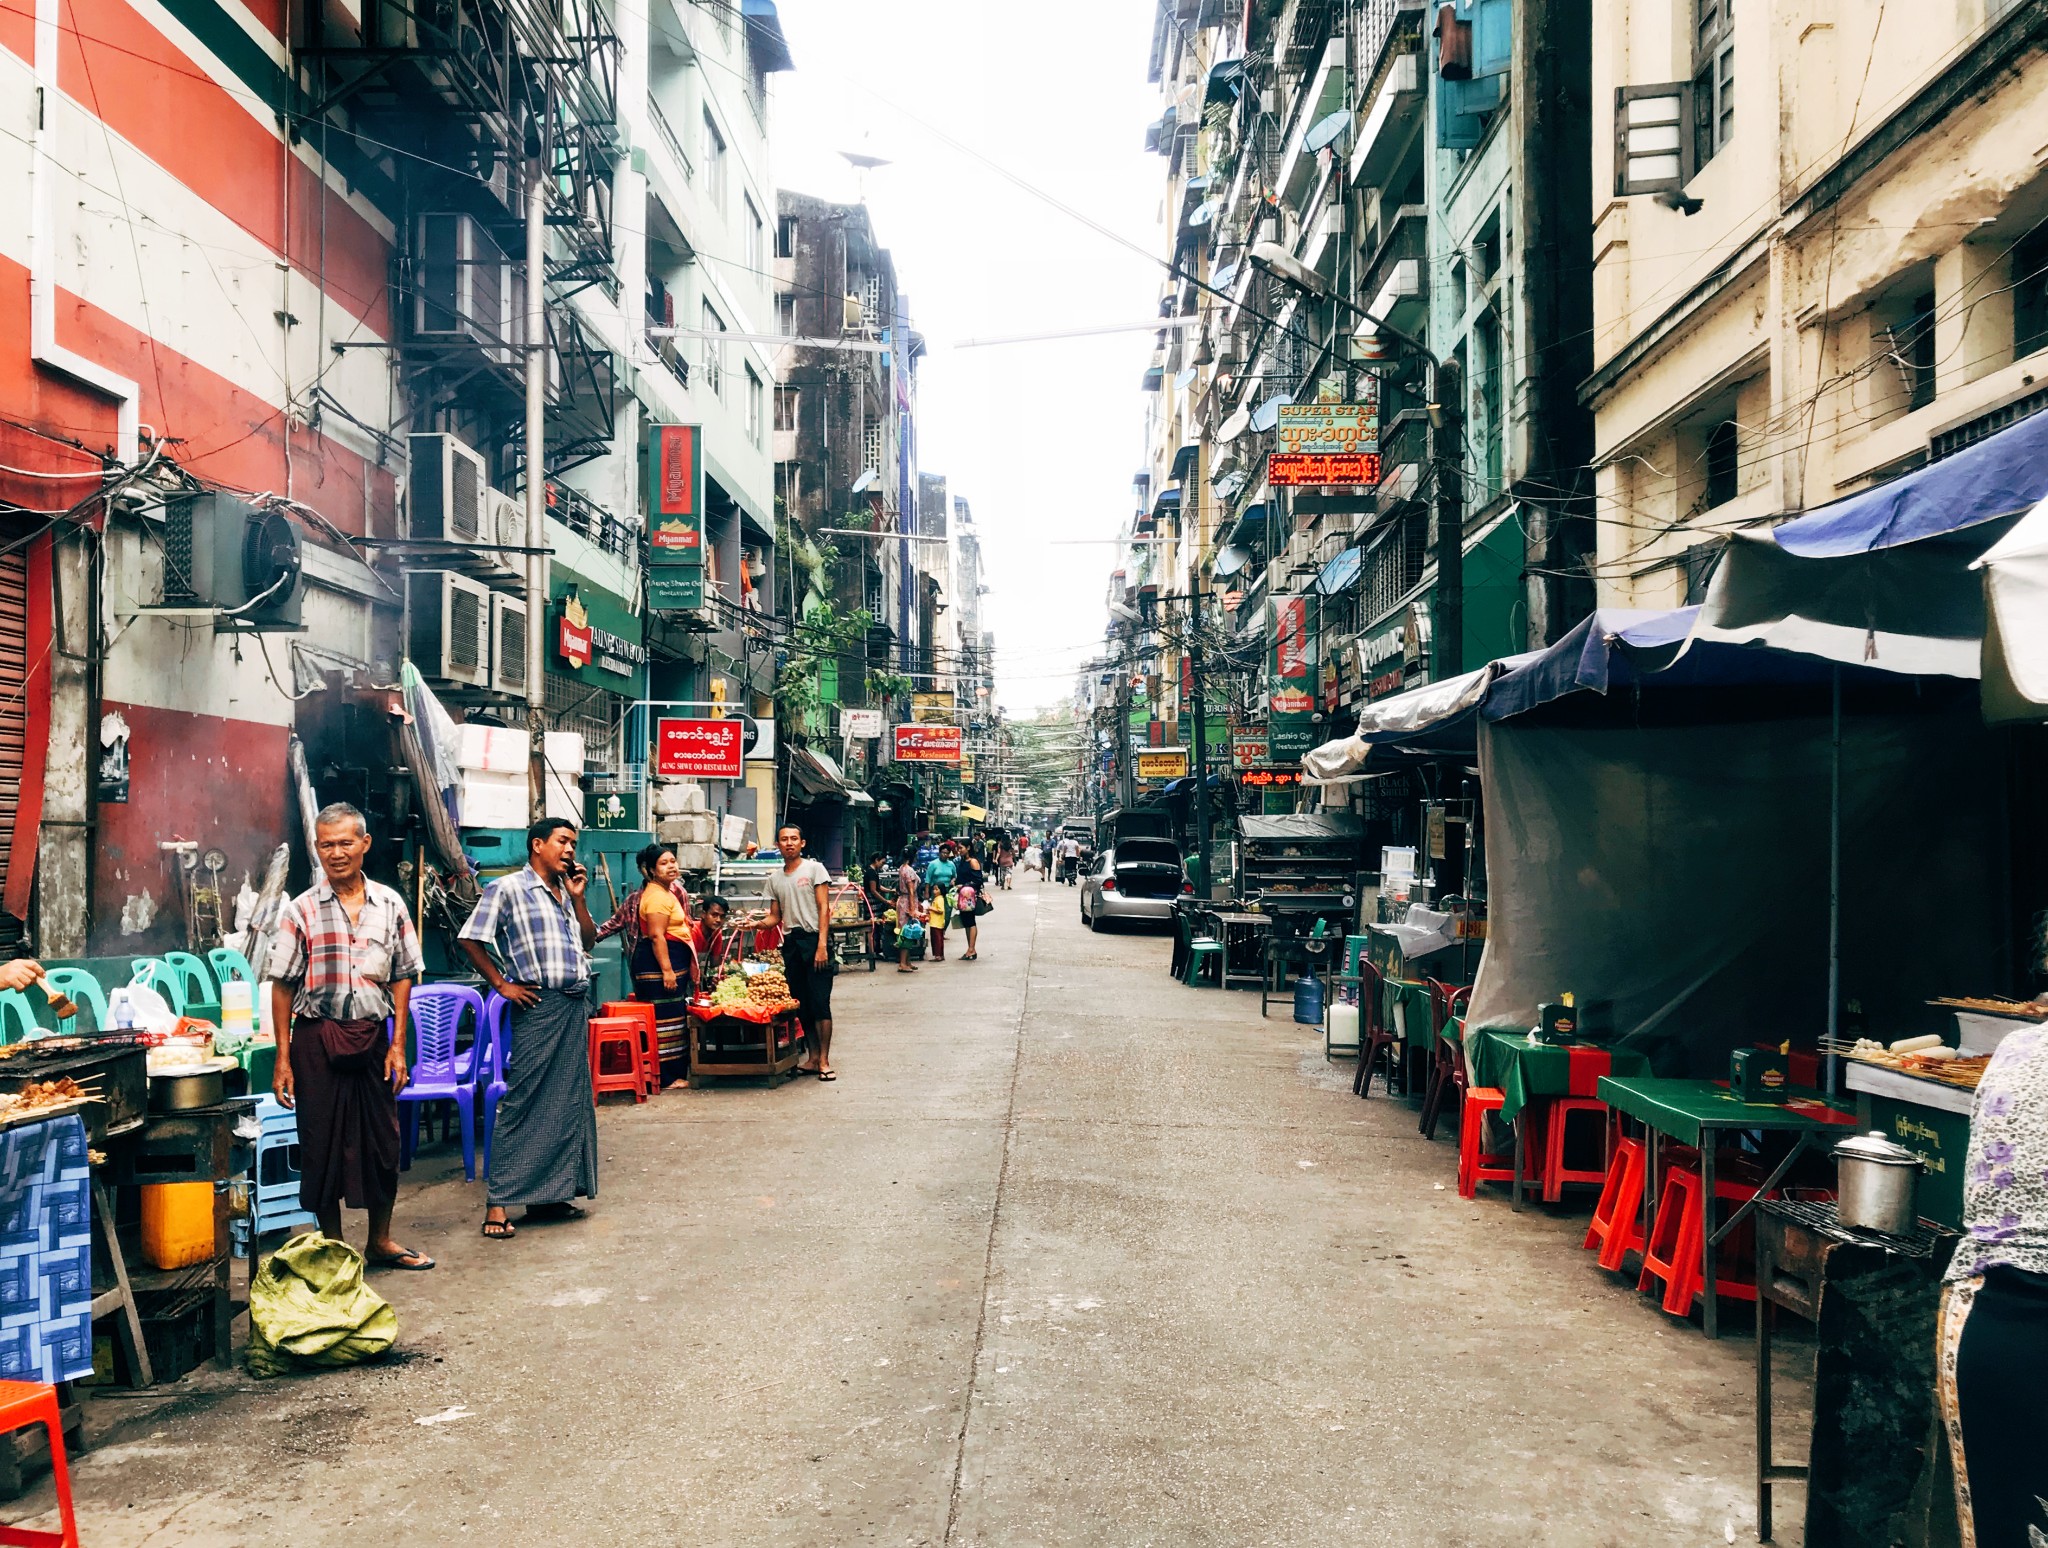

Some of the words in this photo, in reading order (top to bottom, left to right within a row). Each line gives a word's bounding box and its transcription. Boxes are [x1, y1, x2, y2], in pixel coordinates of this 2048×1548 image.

[1280, 406, 1332, 416] SUPER
[1335, 406, 1378, 416] STAR
[658, 534, 694, 545] Myanmar
[1272, 731, 1298, 740] Lashio
[661, 762, 676, 770] AUNG
[693, 763, 702, 771] OO
[703, 763, 739, 772] RESTAURANT
